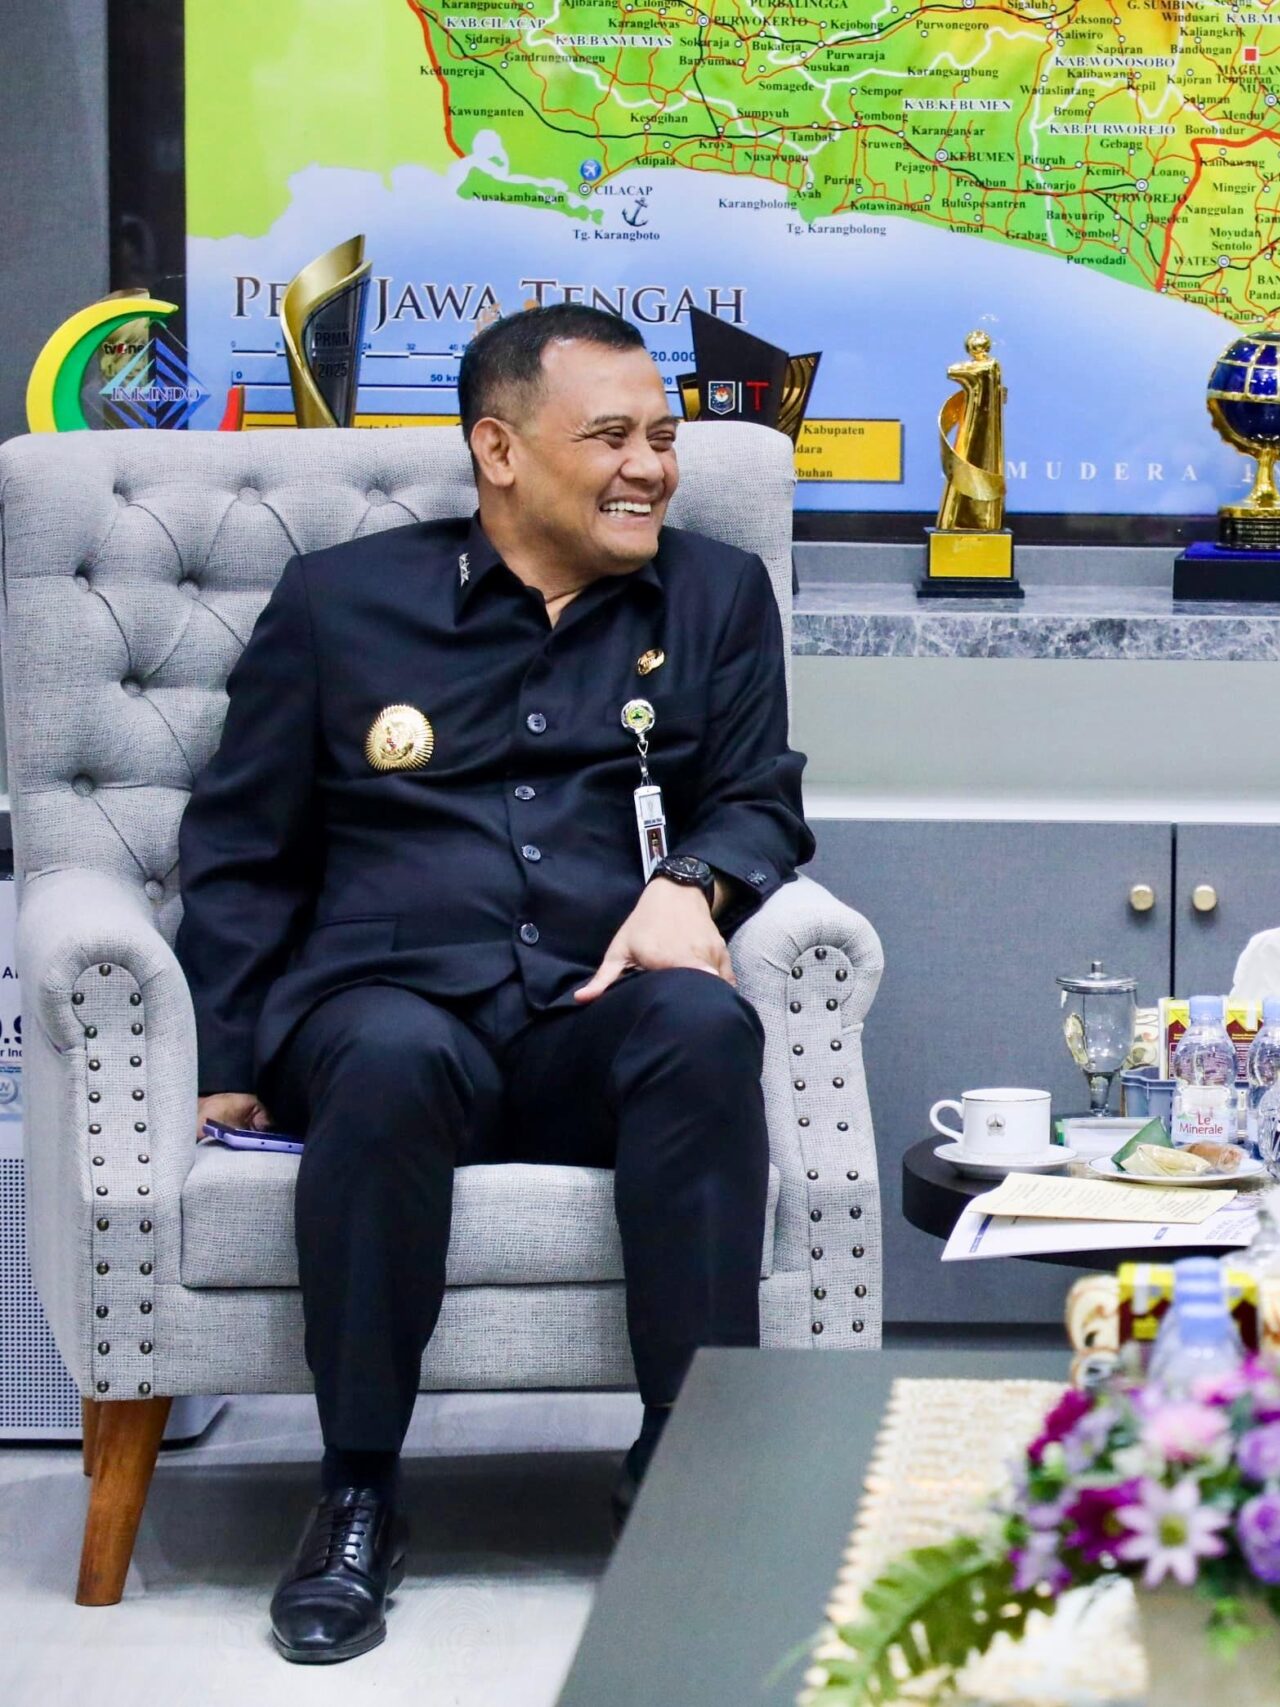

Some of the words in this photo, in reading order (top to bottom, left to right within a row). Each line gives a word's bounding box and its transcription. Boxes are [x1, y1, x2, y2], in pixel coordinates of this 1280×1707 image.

[608, 18, 680, 30] Karanglewas
[915, 20, 989, 31] Purwonegoro
[826, 50, 886, 61] Purwaraja
[420, 65, 485, 77] Kedungreja
[758, 81, 815, 92] Somagede
[860, 86, 904, 97] Sempor
[448, 105, 524, 117] Kawunganten
[232, 276, 289, 318] PE
[430, 374, 443, 382] 50
[110, 386, 201, 402] INKINDO
[803, 424, 865, 437] Kabupaten
[1006, 461, 1198, 482] MUDERA
[1196, 1110, 1211, 1125] Le
[1180, 1123, 1224, 1135] Minerale
